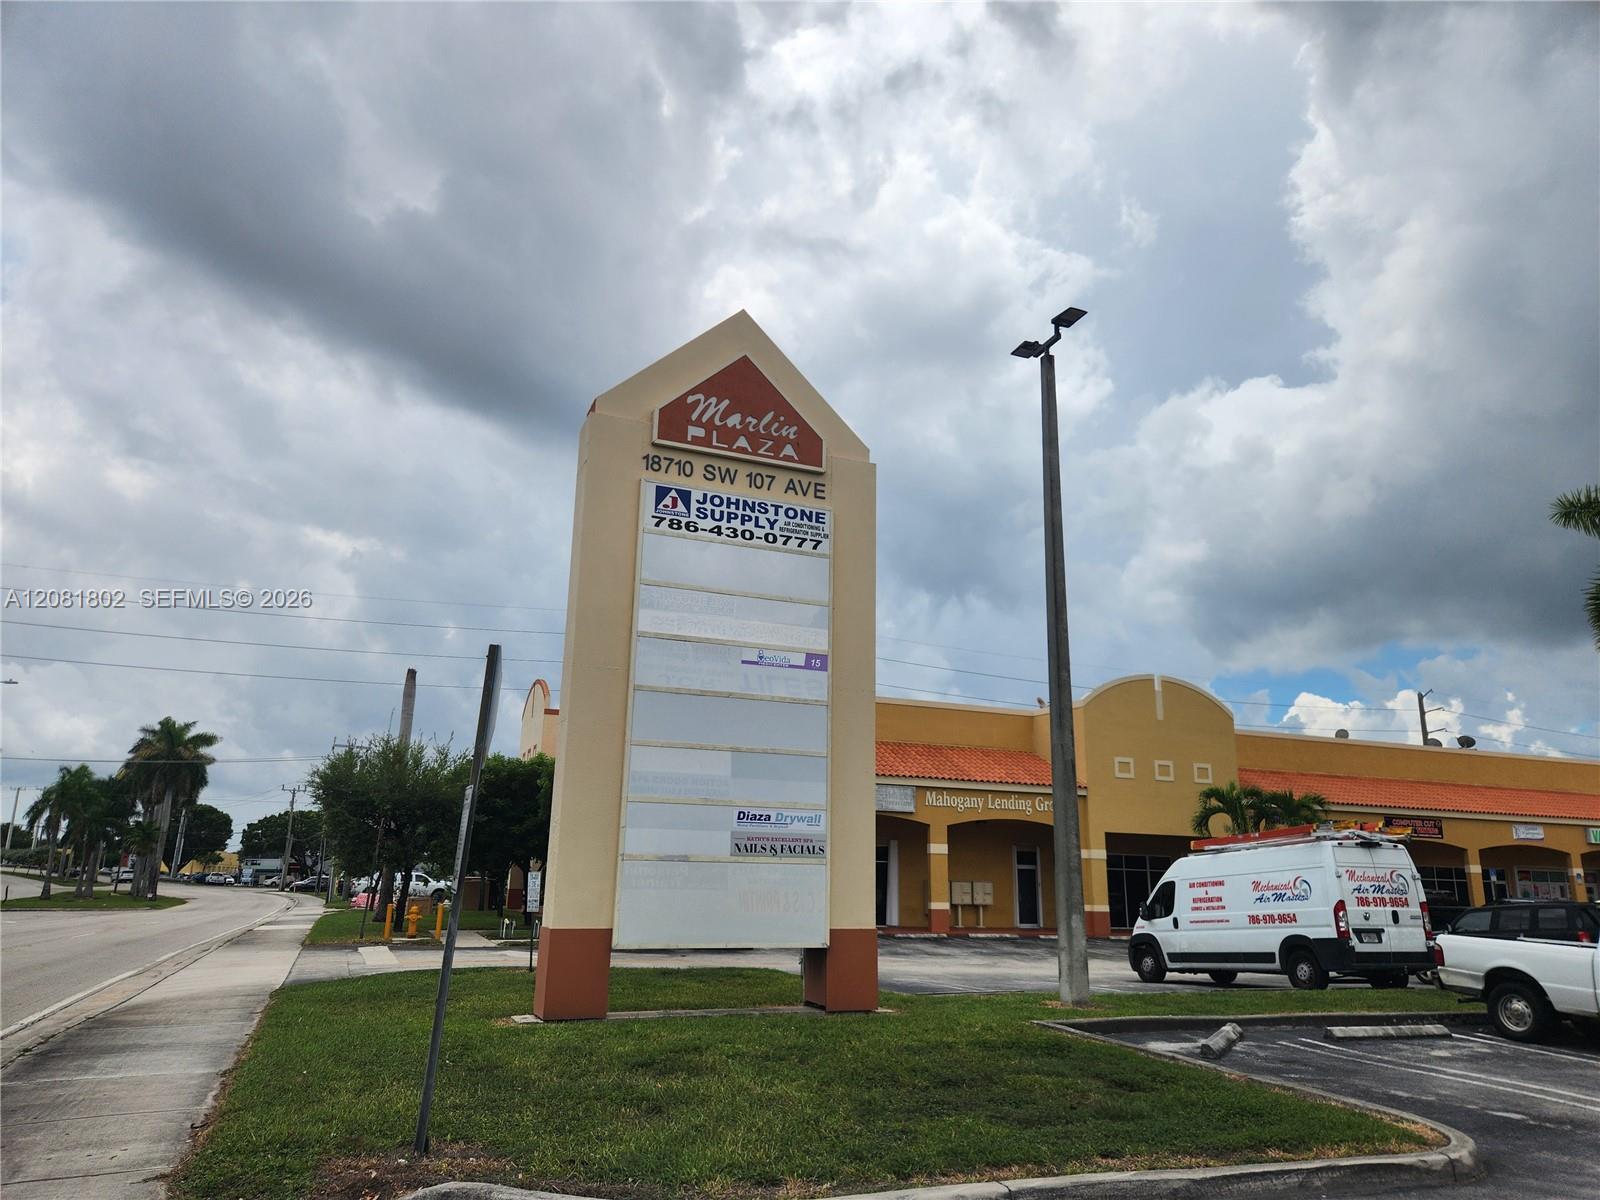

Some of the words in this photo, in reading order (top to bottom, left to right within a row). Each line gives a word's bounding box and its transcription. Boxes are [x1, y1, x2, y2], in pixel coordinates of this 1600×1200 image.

[686, 393, 799, 440] Marlin
[687, 425, 799, 461] PLAZA
[642, 453, 694, 478] 18710
[702, 463, 738, 485] SW
[745, 471, 776, 492] 107
[784, 478, 826, 500] AVE
[695, 492, 826, 525] JOHNSTONE
[695, 506, 779, 531] SUPPLY
[651, 515, 823, 551] 786-430-0777
[779, 526, 809, 537] REFRIGERATION
[792, 521, 821, 532] CONDITIONING
[810, 659, 821, 668] 15
[925, 791, 984, 813] Mahogany
[987, 794, 1032, 815] Lending
[737, 811, 771, 822] Diaza
[775, 812, 822, 825] Drywall
[735, 843, 767, 854] NAILS
[769, 844, 778, 856] &
[780, 844, 825, 855] FACIALS
[1345, 869, 1389, 883] Mechanical
[1196, 880, 1225, 888] CONDITIONING
[1251, 880, 1292, 892] Mechanical
[1351, 884, 1369, 895] Air
[1370, 884, 1409, 895] Masters
[1253, 893, 1271, 904] Air
[1271, 892, 1309, 903] Masters
[1355, 896, 1409, 908] 786-970-9654
[1247, 913, 1297, 925] 786-970-9654
